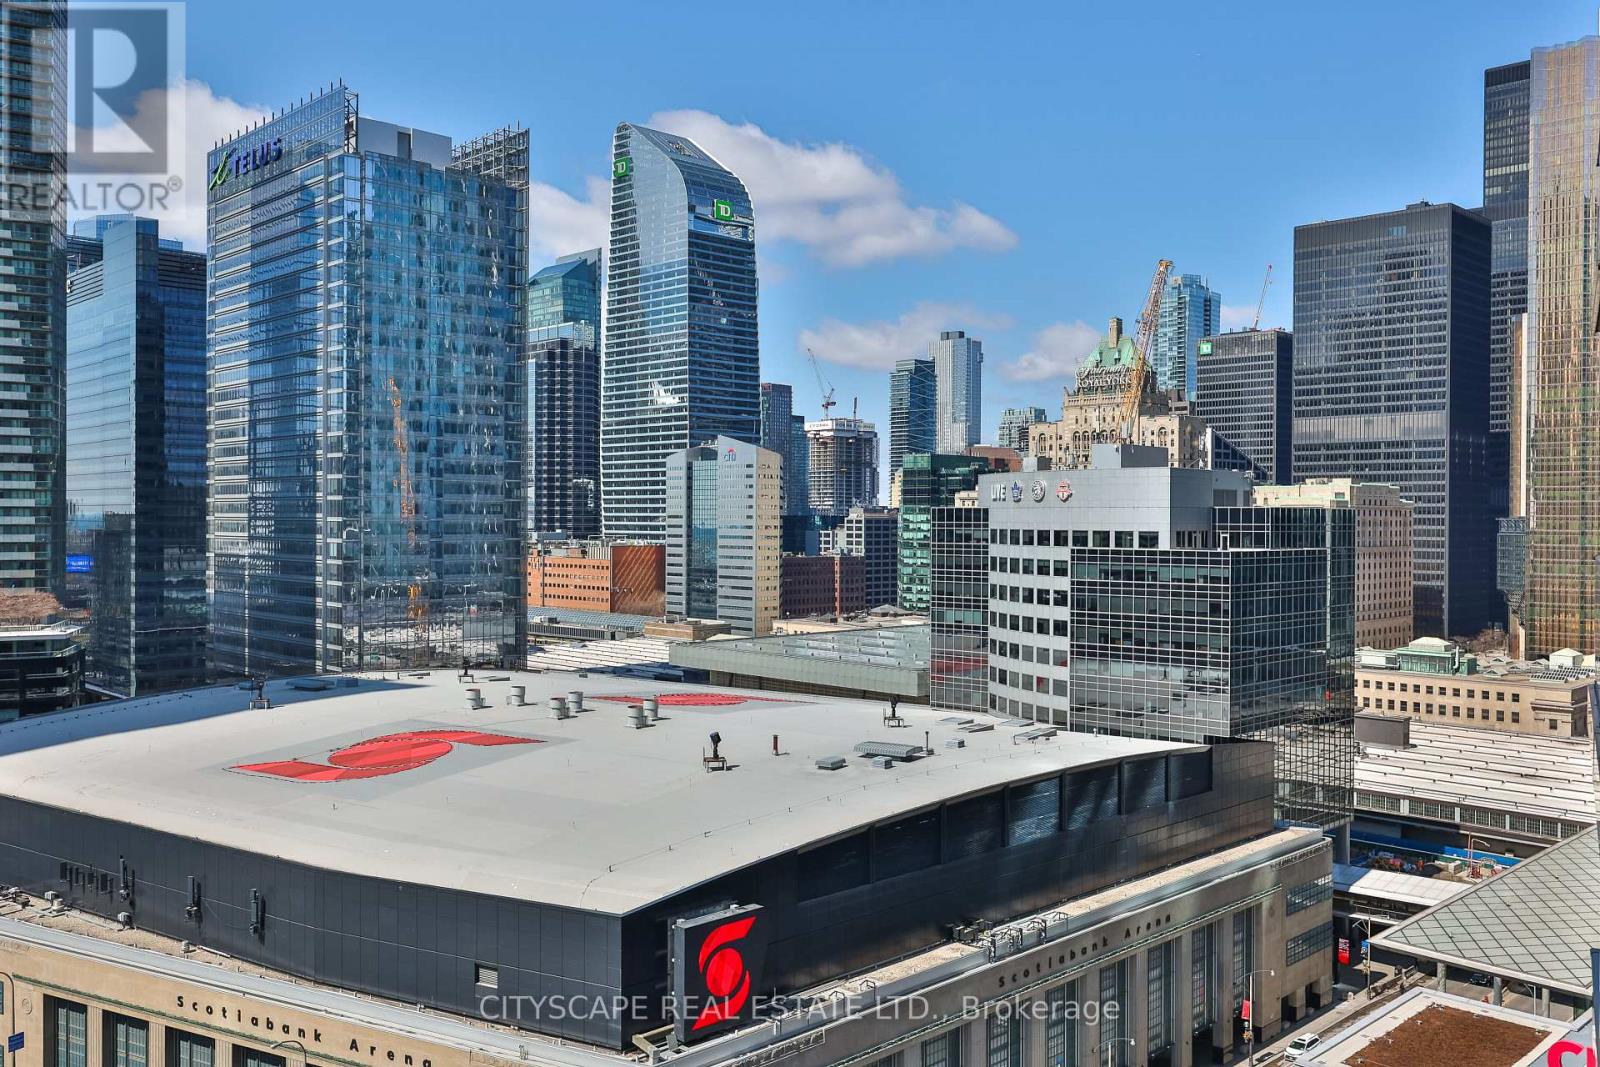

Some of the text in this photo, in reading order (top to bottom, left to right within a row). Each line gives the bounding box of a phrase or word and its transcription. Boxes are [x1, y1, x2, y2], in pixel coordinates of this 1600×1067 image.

[231, 138, 282, 178] TELUS
[998, 914, 1171, 988] Scotiabank Arena
[177, 995, 433, 1067] Scotiabank Arena
